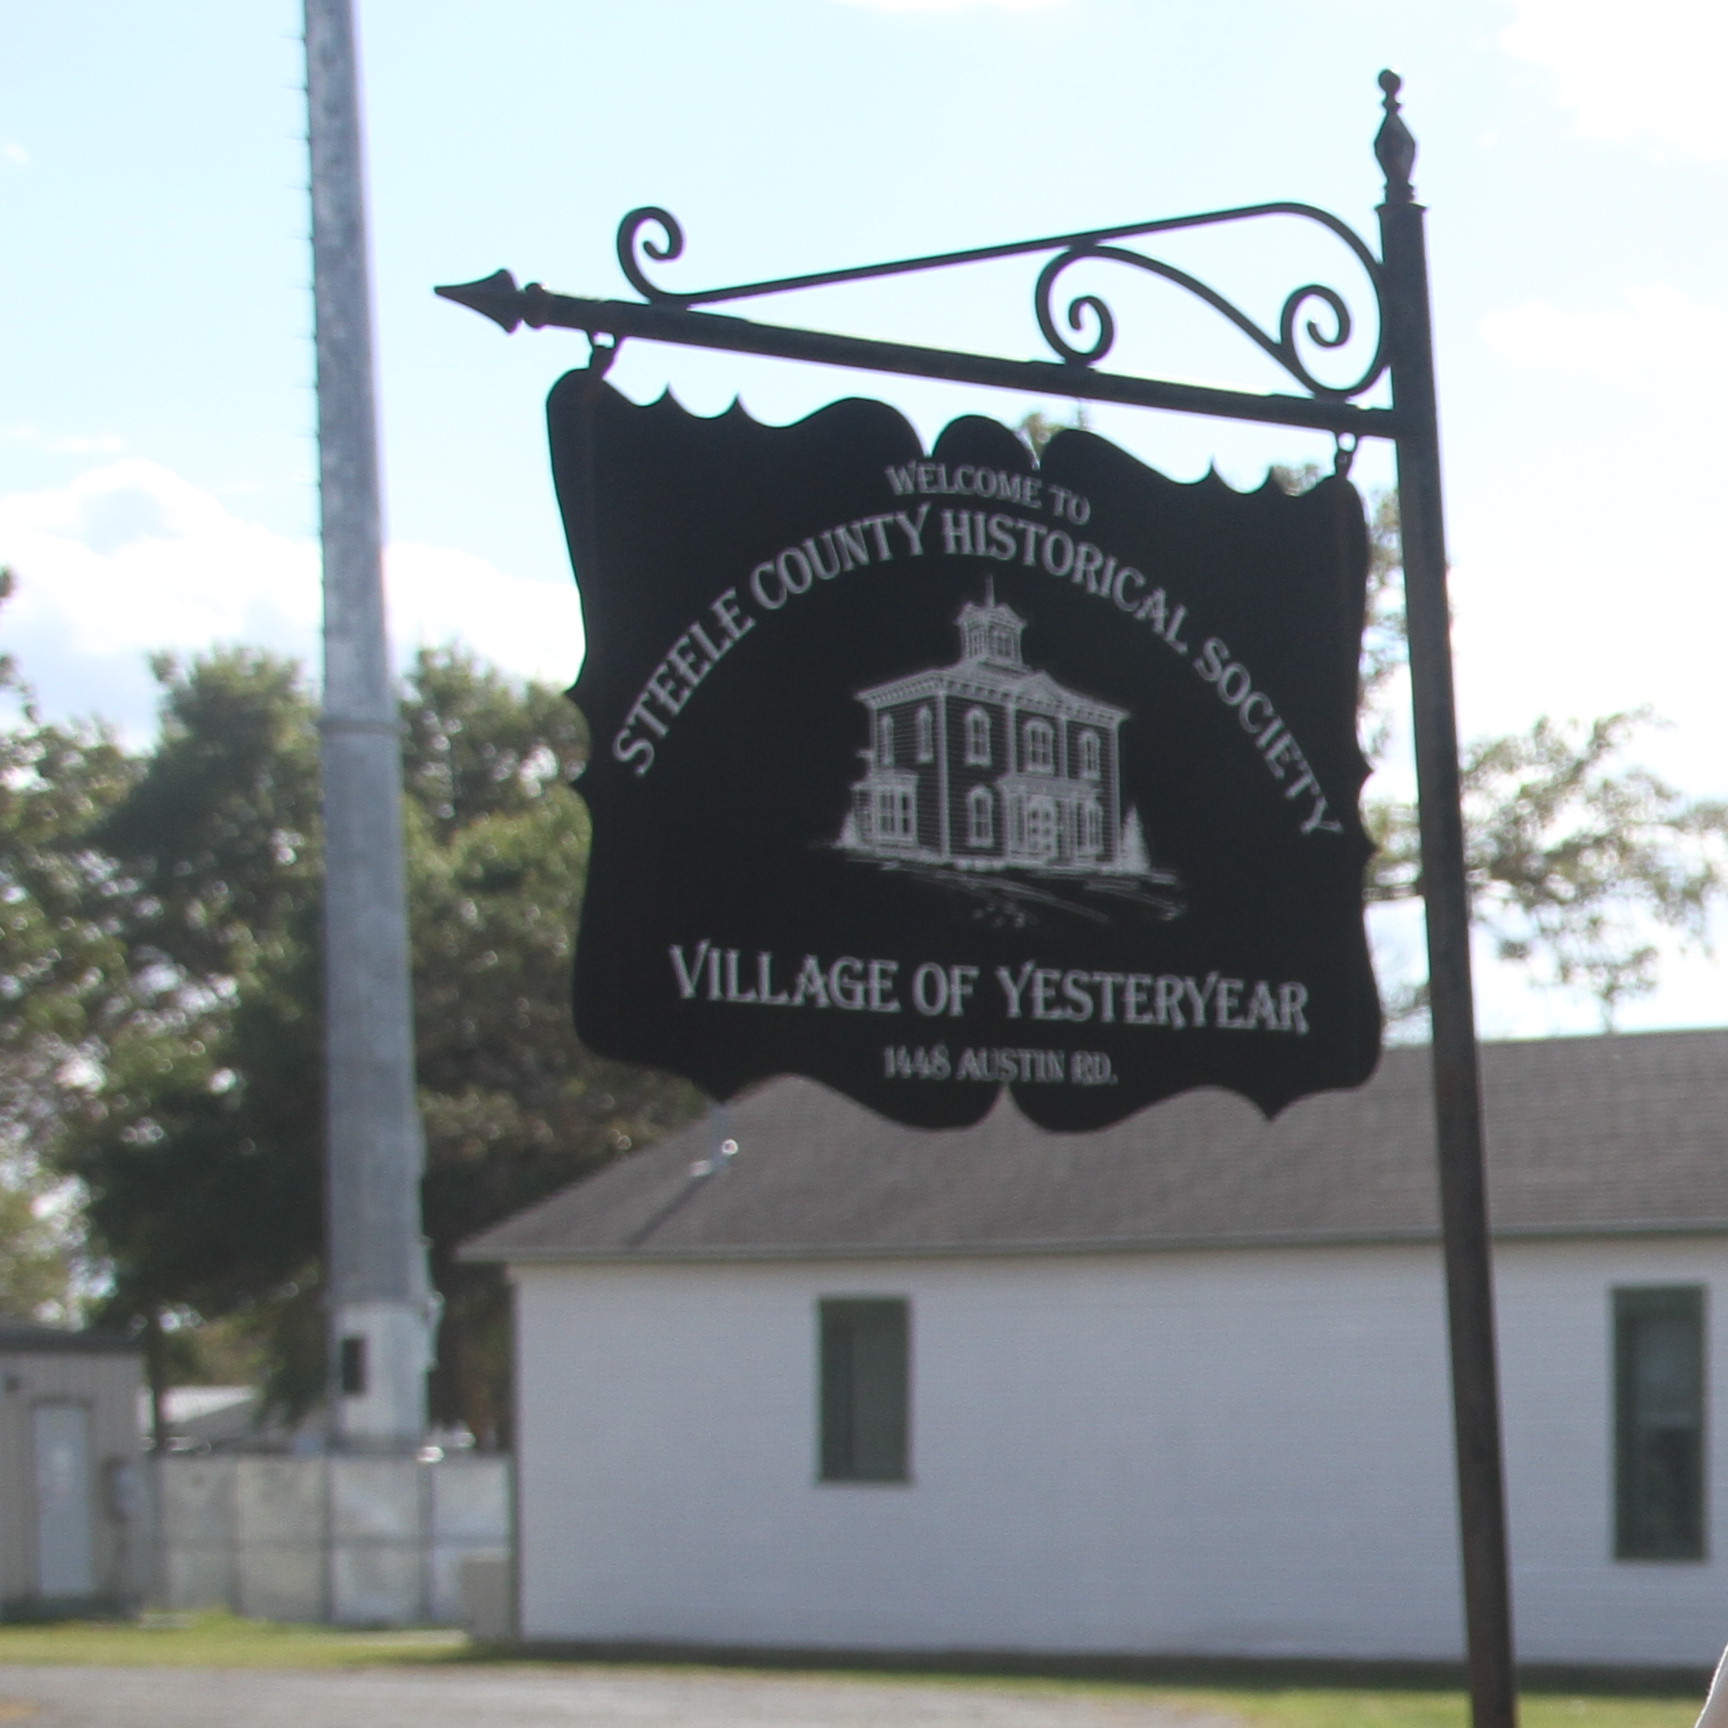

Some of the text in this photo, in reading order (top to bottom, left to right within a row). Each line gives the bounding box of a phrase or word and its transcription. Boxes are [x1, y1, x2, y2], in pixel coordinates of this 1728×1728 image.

[885, 460, 1091, 525] WELCOME TO
[612, 502, 1343, 834] STEELE COUNTY HISTORICAL SOCIETY
[669, 939, 1310, 1035] VILLAGE OF YESTERYEAR
[883, 1044, 1118, 1086] 1448 AUSTIN RD.
